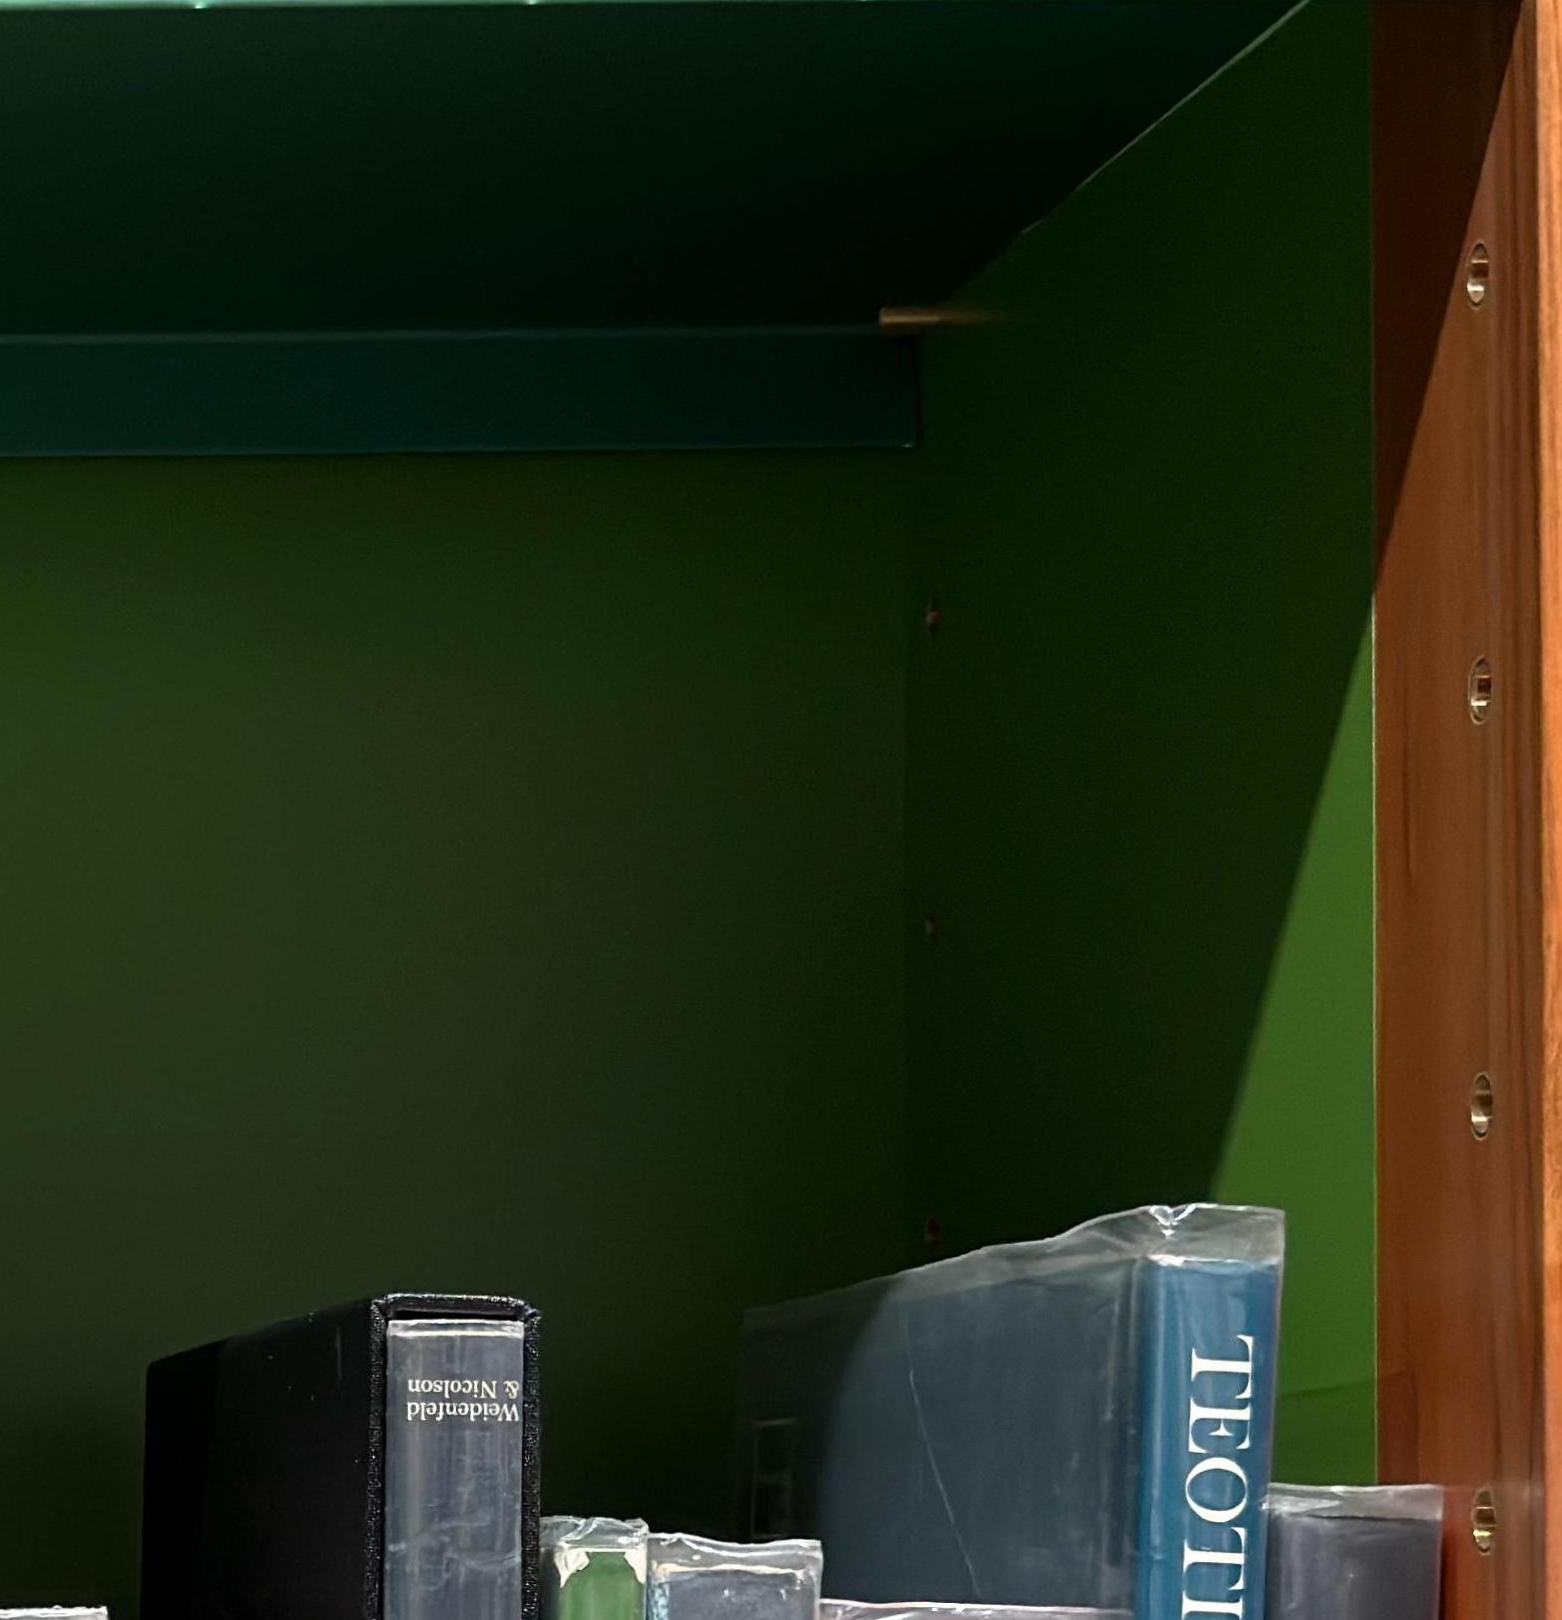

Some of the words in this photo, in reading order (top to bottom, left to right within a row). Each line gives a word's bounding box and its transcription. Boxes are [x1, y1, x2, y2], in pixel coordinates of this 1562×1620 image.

[408, 1378, 498, 1398] Nicolson
[503, 1380, 520, 1397] &
[407, 1401, 520, 1422] Weidenfeld
